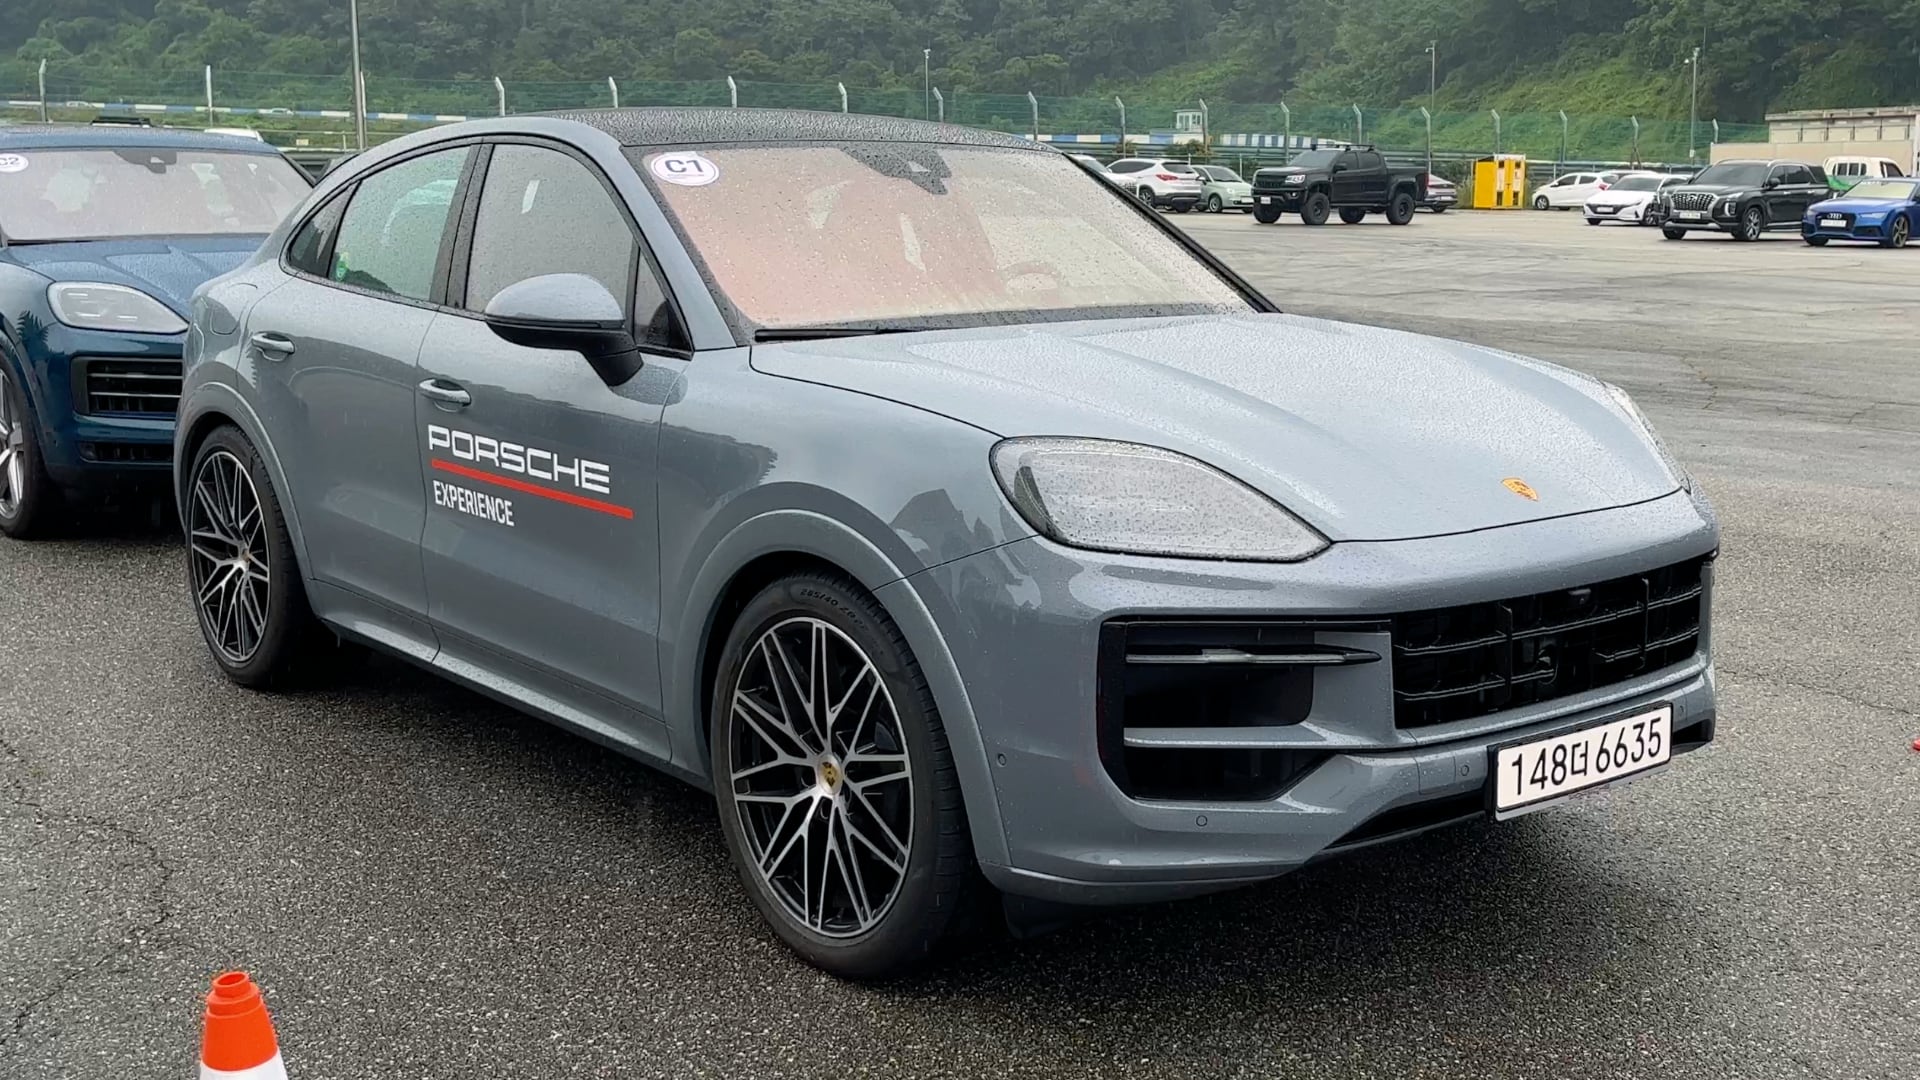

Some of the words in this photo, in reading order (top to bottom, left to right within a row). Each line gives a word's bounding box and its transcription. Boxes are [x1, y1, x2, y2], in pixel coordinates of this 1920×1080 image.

[664, 159, 704, 173] C1
[427, 424, 610, 494] PORSCHE
[432, 480, 515, 527] EXPERIENCE
